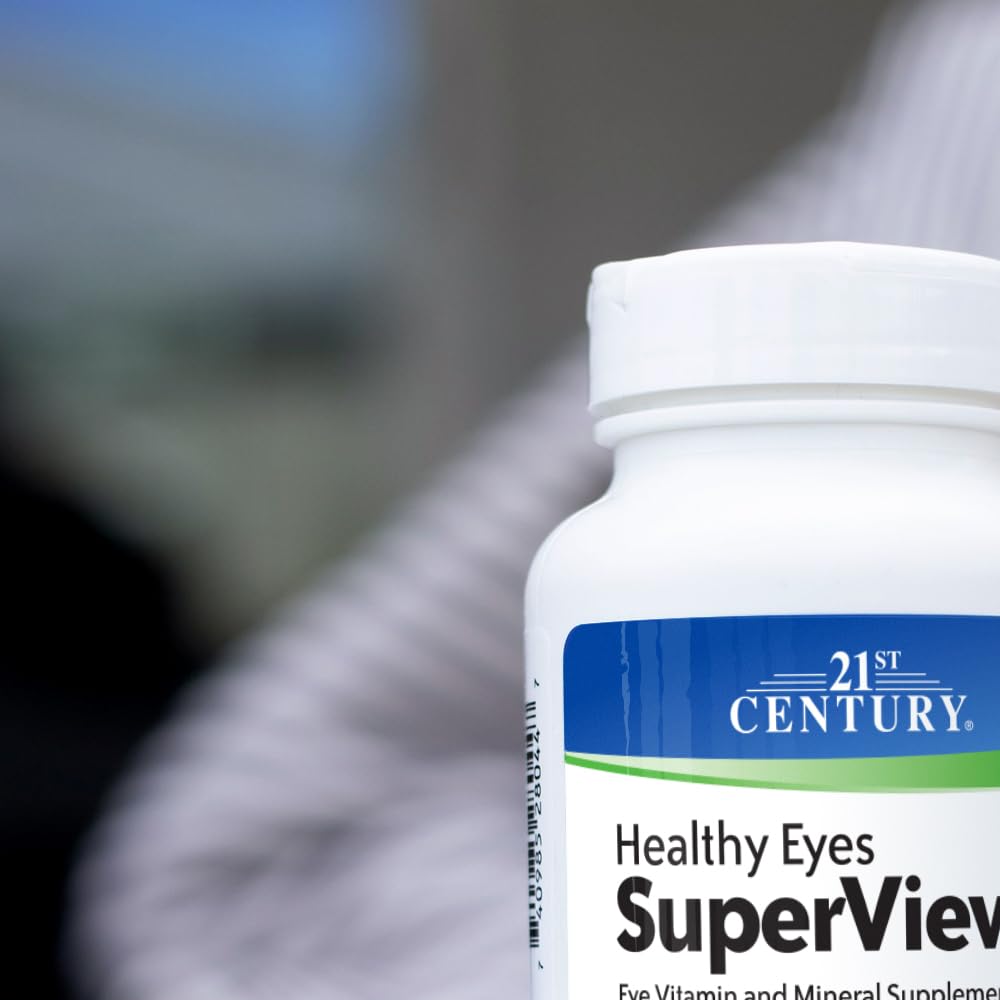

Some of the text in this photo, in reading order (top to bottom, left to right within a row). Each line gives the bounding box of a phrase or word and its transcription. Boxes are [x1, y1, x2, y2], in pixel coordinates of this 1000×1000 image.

[829, 650, 901, 692] 21ST
[532, 727, 543, 815] 28044
[534, 832, 544, 921] 40985
[616, 819, 875, 877] Healthy Eyes
